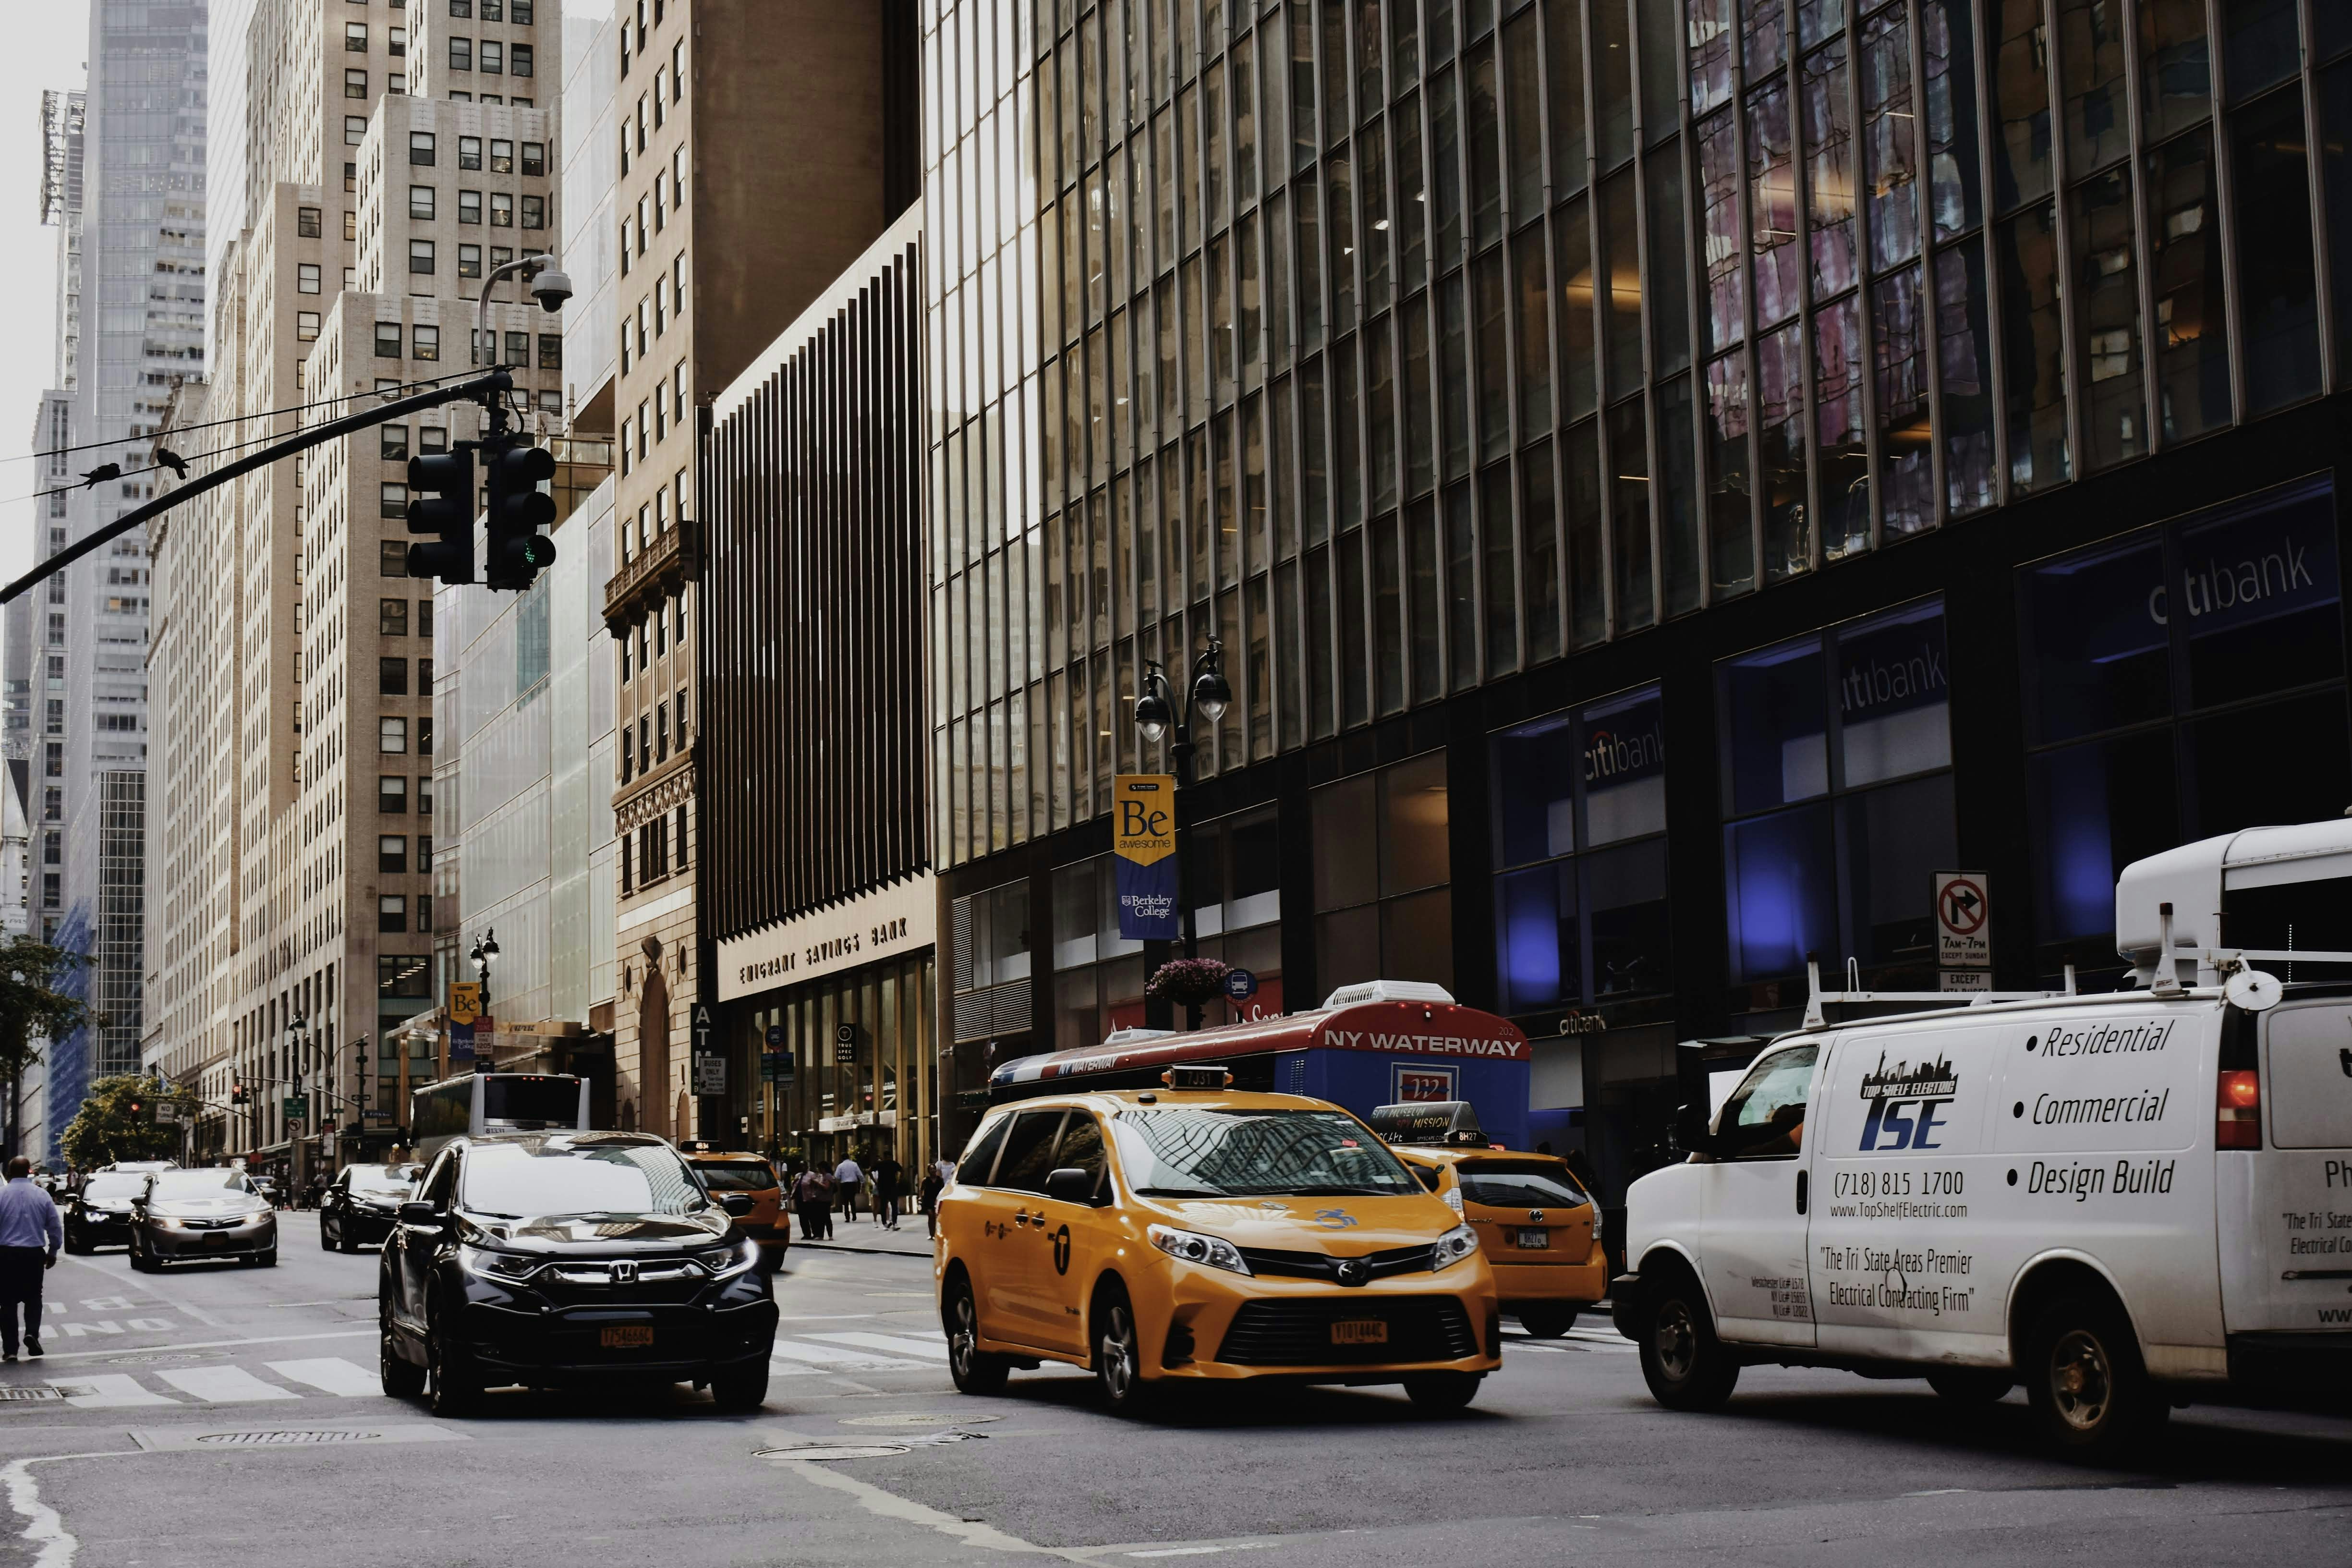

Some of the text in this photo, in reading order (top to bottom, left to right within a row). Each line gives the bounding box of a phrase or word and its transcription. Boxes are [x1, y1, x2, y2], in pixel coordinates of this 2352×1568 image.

[2148, 535, 2313, 625] ctibank
[1119, 801, 1169, 837] Be
[1119, 839, 1171, 849] awesome
[1131, 894, 1172, 908] Berkeley
[1135, 906, 1170, 919] College
[740, 917, 907, 984] EMIGRANT SAVINGS BANK
[1951, 974, 1980, 984] EXCEPT
[453, 994, 477, 1012] Be
[1498, 1027, 1514, 1036] 202
[1559, 1010, 1606, 1035] citibank
[1324, 1029, 1522, 1057] NY WATERWAY
[2042, 1020, 2175, 1057] Residential
[1058, 1056, 1118, 1075] NY WATERWAY
[1187, 1071, 1211, 1085] 7J31
[1863, 1081, 1955, 1098] TOP SHELF ELECTRIC
[1389, 1106, 1426, 1118] MUSEUM
[2034, 1088, 2170, 1125] Commercial
[1413, 1117, 1450, 1129] MISSION
[1459, 1131, 1477, 1142] 8H27
[1835, 1171, 1963, 1198] (718) 815 1700
[2028, 1159, 2175, 1202] Design Build
[1831, 1202, 1967, 1221] www.TopShelfElectric.com
[2309, 1213, 2322, 1229] Tri
[2327, 1212, 2352, 1228] State
[2291, 1237, 2337, 1254] Electrical
[1821, 1247, 1972, 1274] "The Tri State Areas Premier
[1830, 1282, 1975, 1316] Electrical Contracting Firm"
